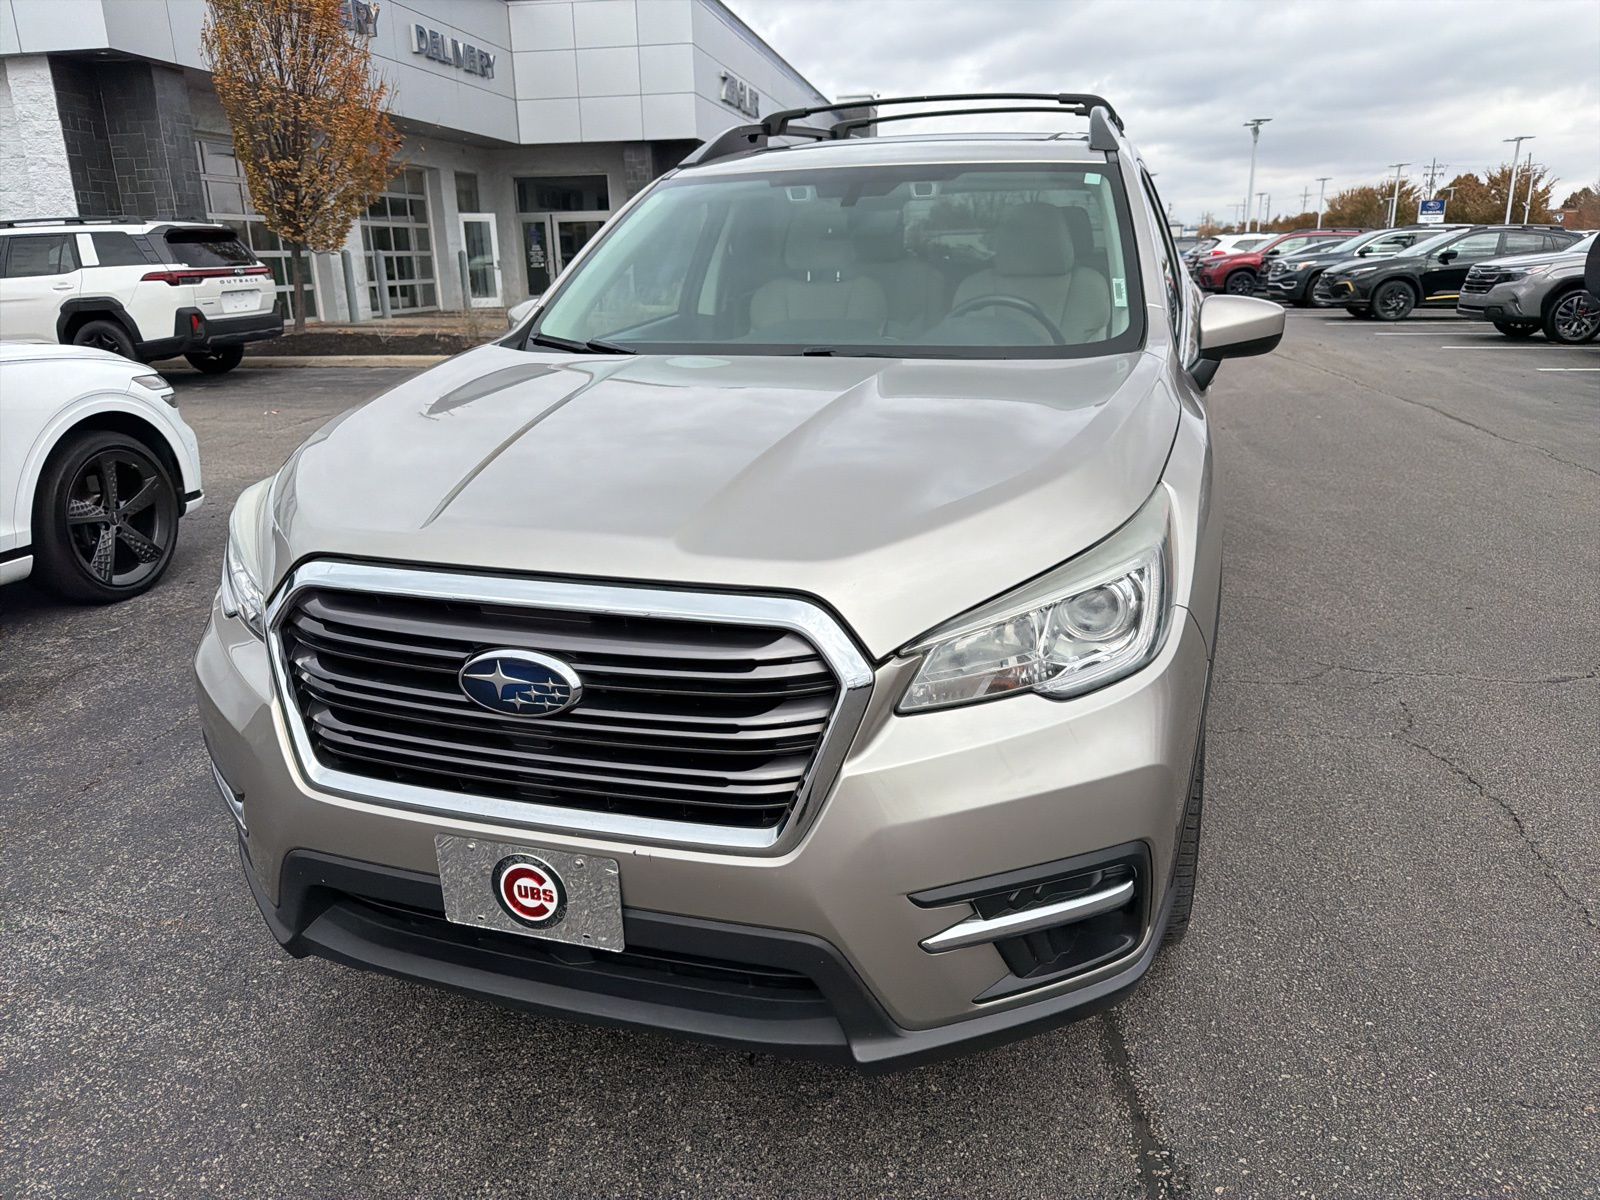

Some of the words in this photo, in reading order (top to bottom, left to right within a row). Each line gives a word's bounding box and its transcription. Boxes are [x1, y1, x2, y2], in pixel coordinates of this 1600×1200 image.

[411, 23, 496, 79] DELIVERY
[219, 277, 259, 285] OUTBACK
[503, 867, 555, 917] CUBS
